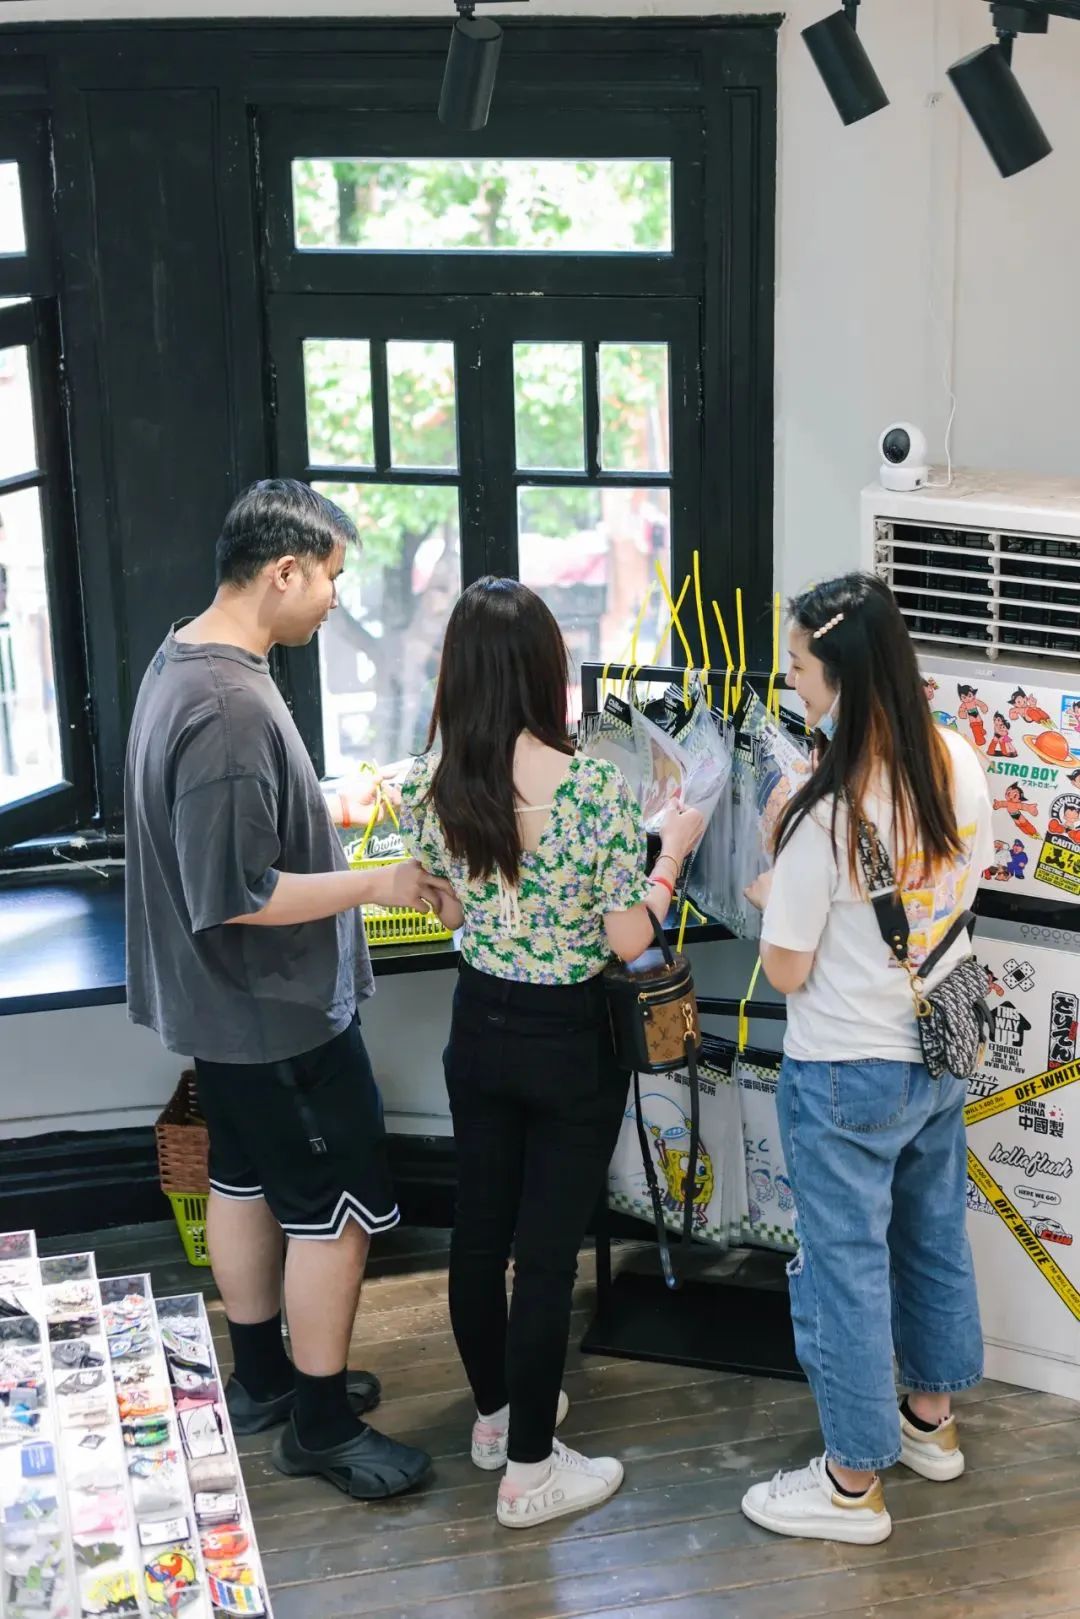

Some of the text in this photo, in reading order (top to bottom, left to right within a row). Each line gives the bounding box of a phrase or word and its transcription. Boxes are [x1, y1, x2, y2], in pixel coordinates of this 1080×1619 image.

[987, 761, 1059, 781] ASTRO BOY
[1051, 836, 1080, 853] CAUTIO
[996, 1006, 1021, 1021] THIS
[995, 1016, 1020, 1032] WAY
[994, 1028, 1021, 1047] UP
[1001, 1064, 1013, 1072] YOU
[664, 1070, 717, 1096] 不雷同究所
[1018, 1104, 1046, 1118] CHINA
[1038, 1101, 1046, 1109] IN
[1018, 1114, 1064, 1139] 中國製
[1018, 1189, 1058, 1202] HERE WE GO!
[994, 1199, 1051, 1266] OFF-WHITE
